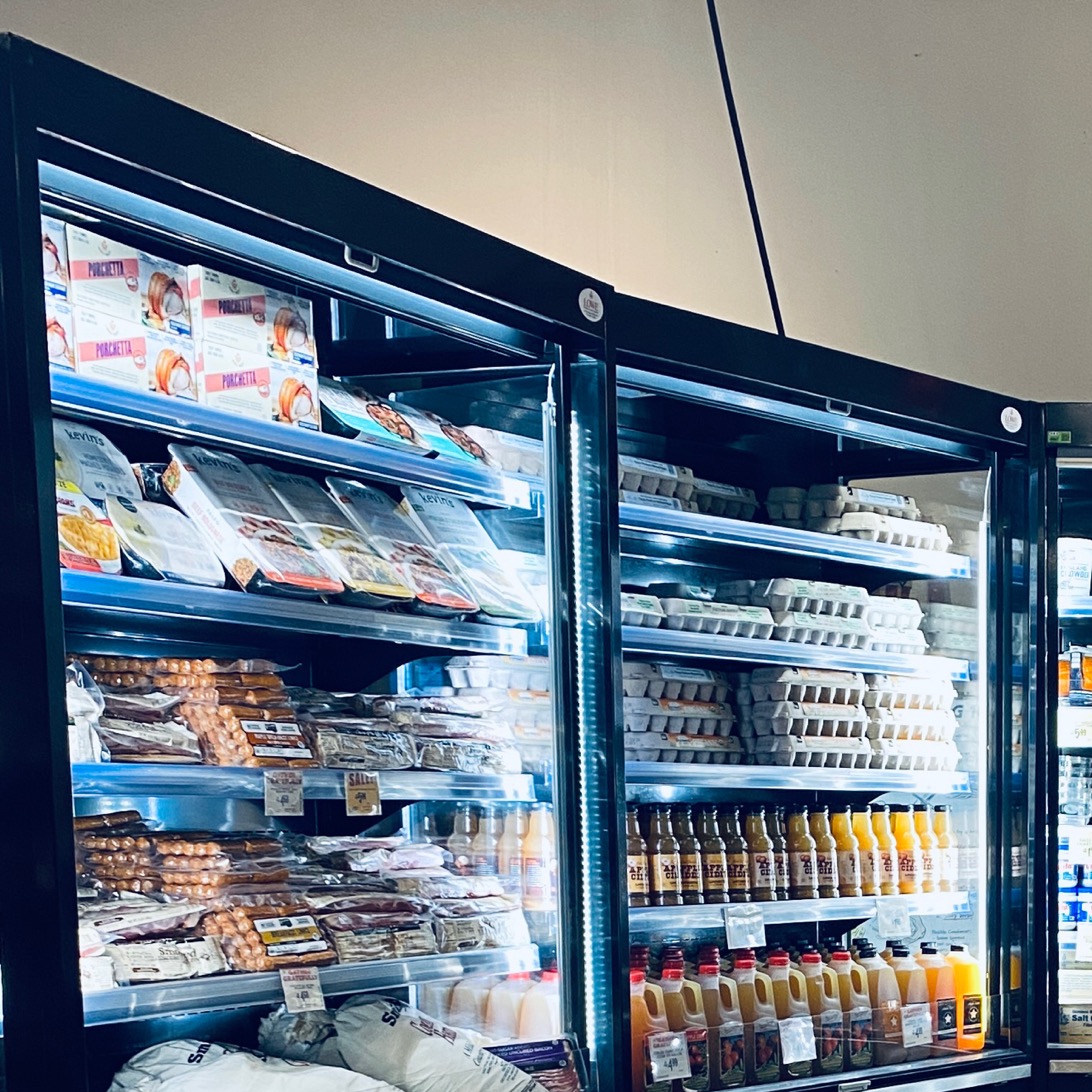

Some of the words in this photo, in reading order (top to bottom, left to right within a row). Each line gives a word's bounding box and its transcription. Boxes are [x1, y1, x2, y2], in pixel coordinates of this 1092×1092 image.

[88, 260, 124, 278] PORCHETTA
[218, 297, 254, 316] PORCHETTA
[95, 340, 132, 356] PORCHETTA
[222, 371, 257, 388] PORCHETTA
[64, 428, 105, 447] kevin's
[191, 451, 241, 475] kevin's
[1071, 1014, 1089, 1022] Salt
